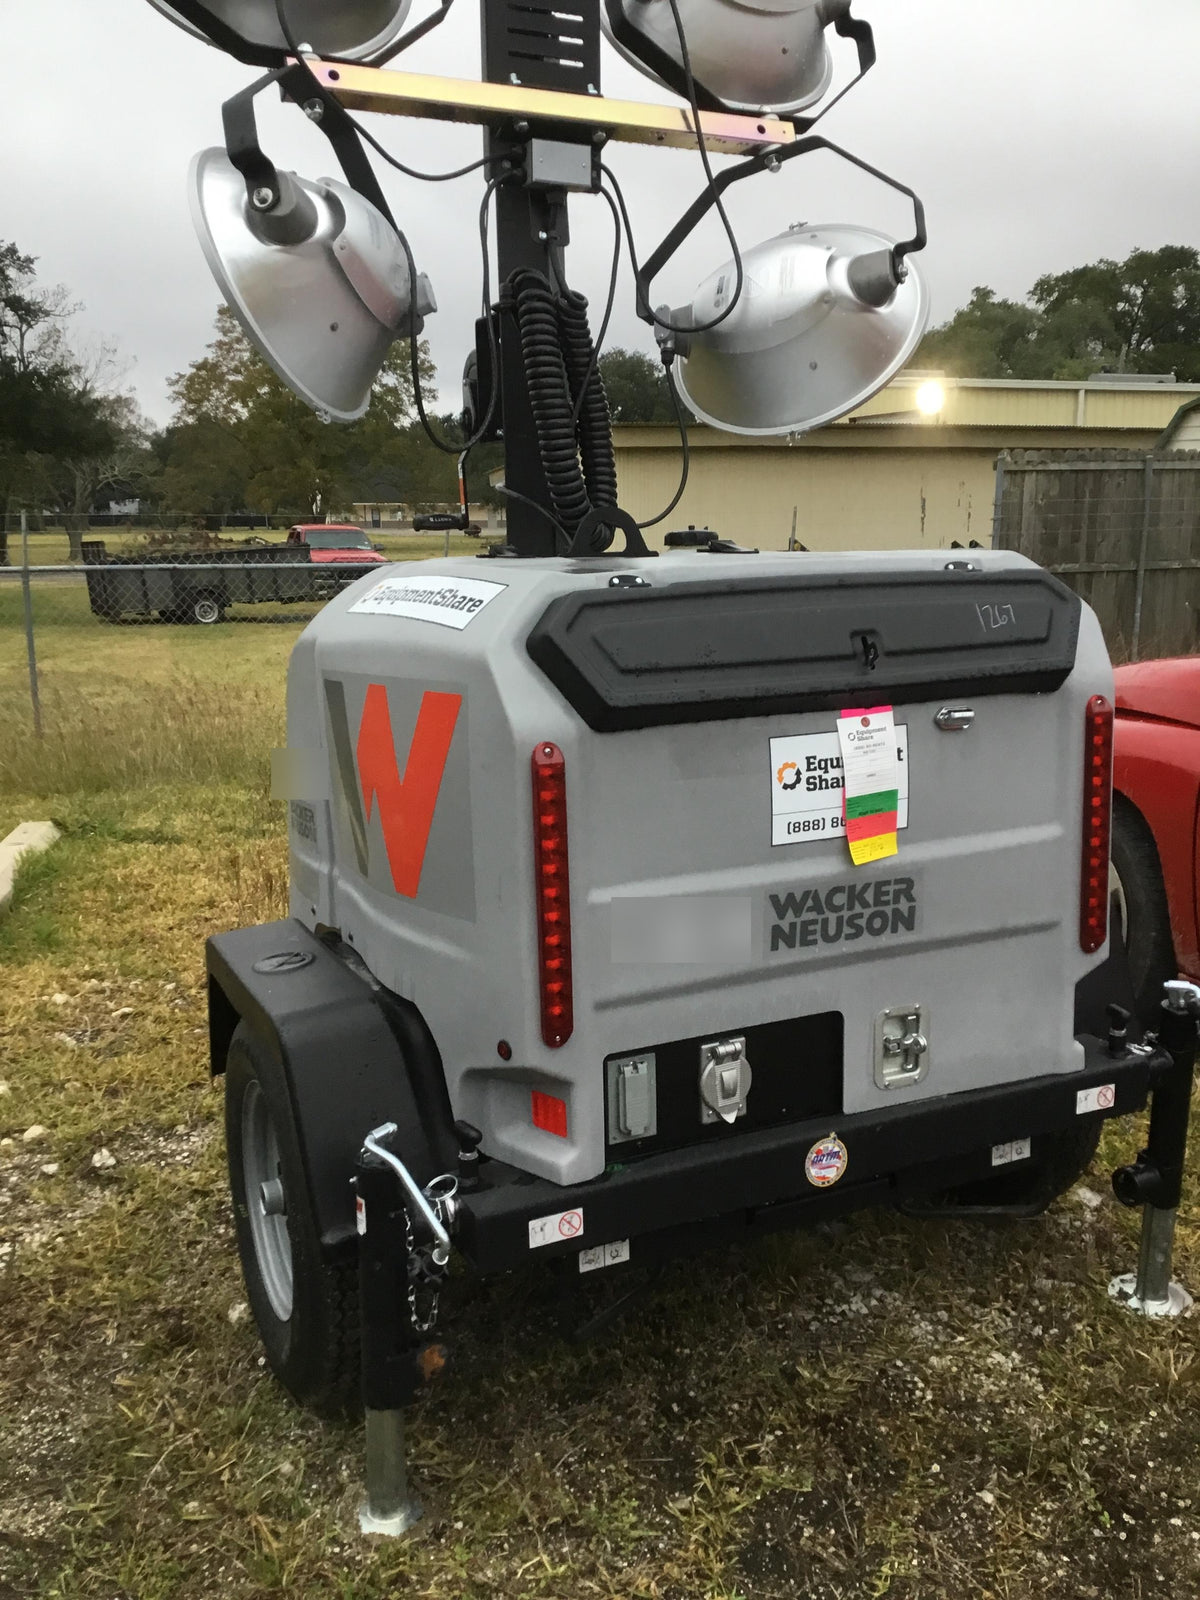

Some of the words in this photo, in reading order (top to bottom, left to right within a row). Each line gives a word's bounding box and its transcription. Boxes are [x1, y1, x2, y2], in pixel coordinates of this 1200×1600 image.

[975, 603, 1016, 632] 1267
[787, 817, 826, 835] (888)
[769, 877, 916, 920] WACKER
[770, 905, 916, 951] NEUSON
